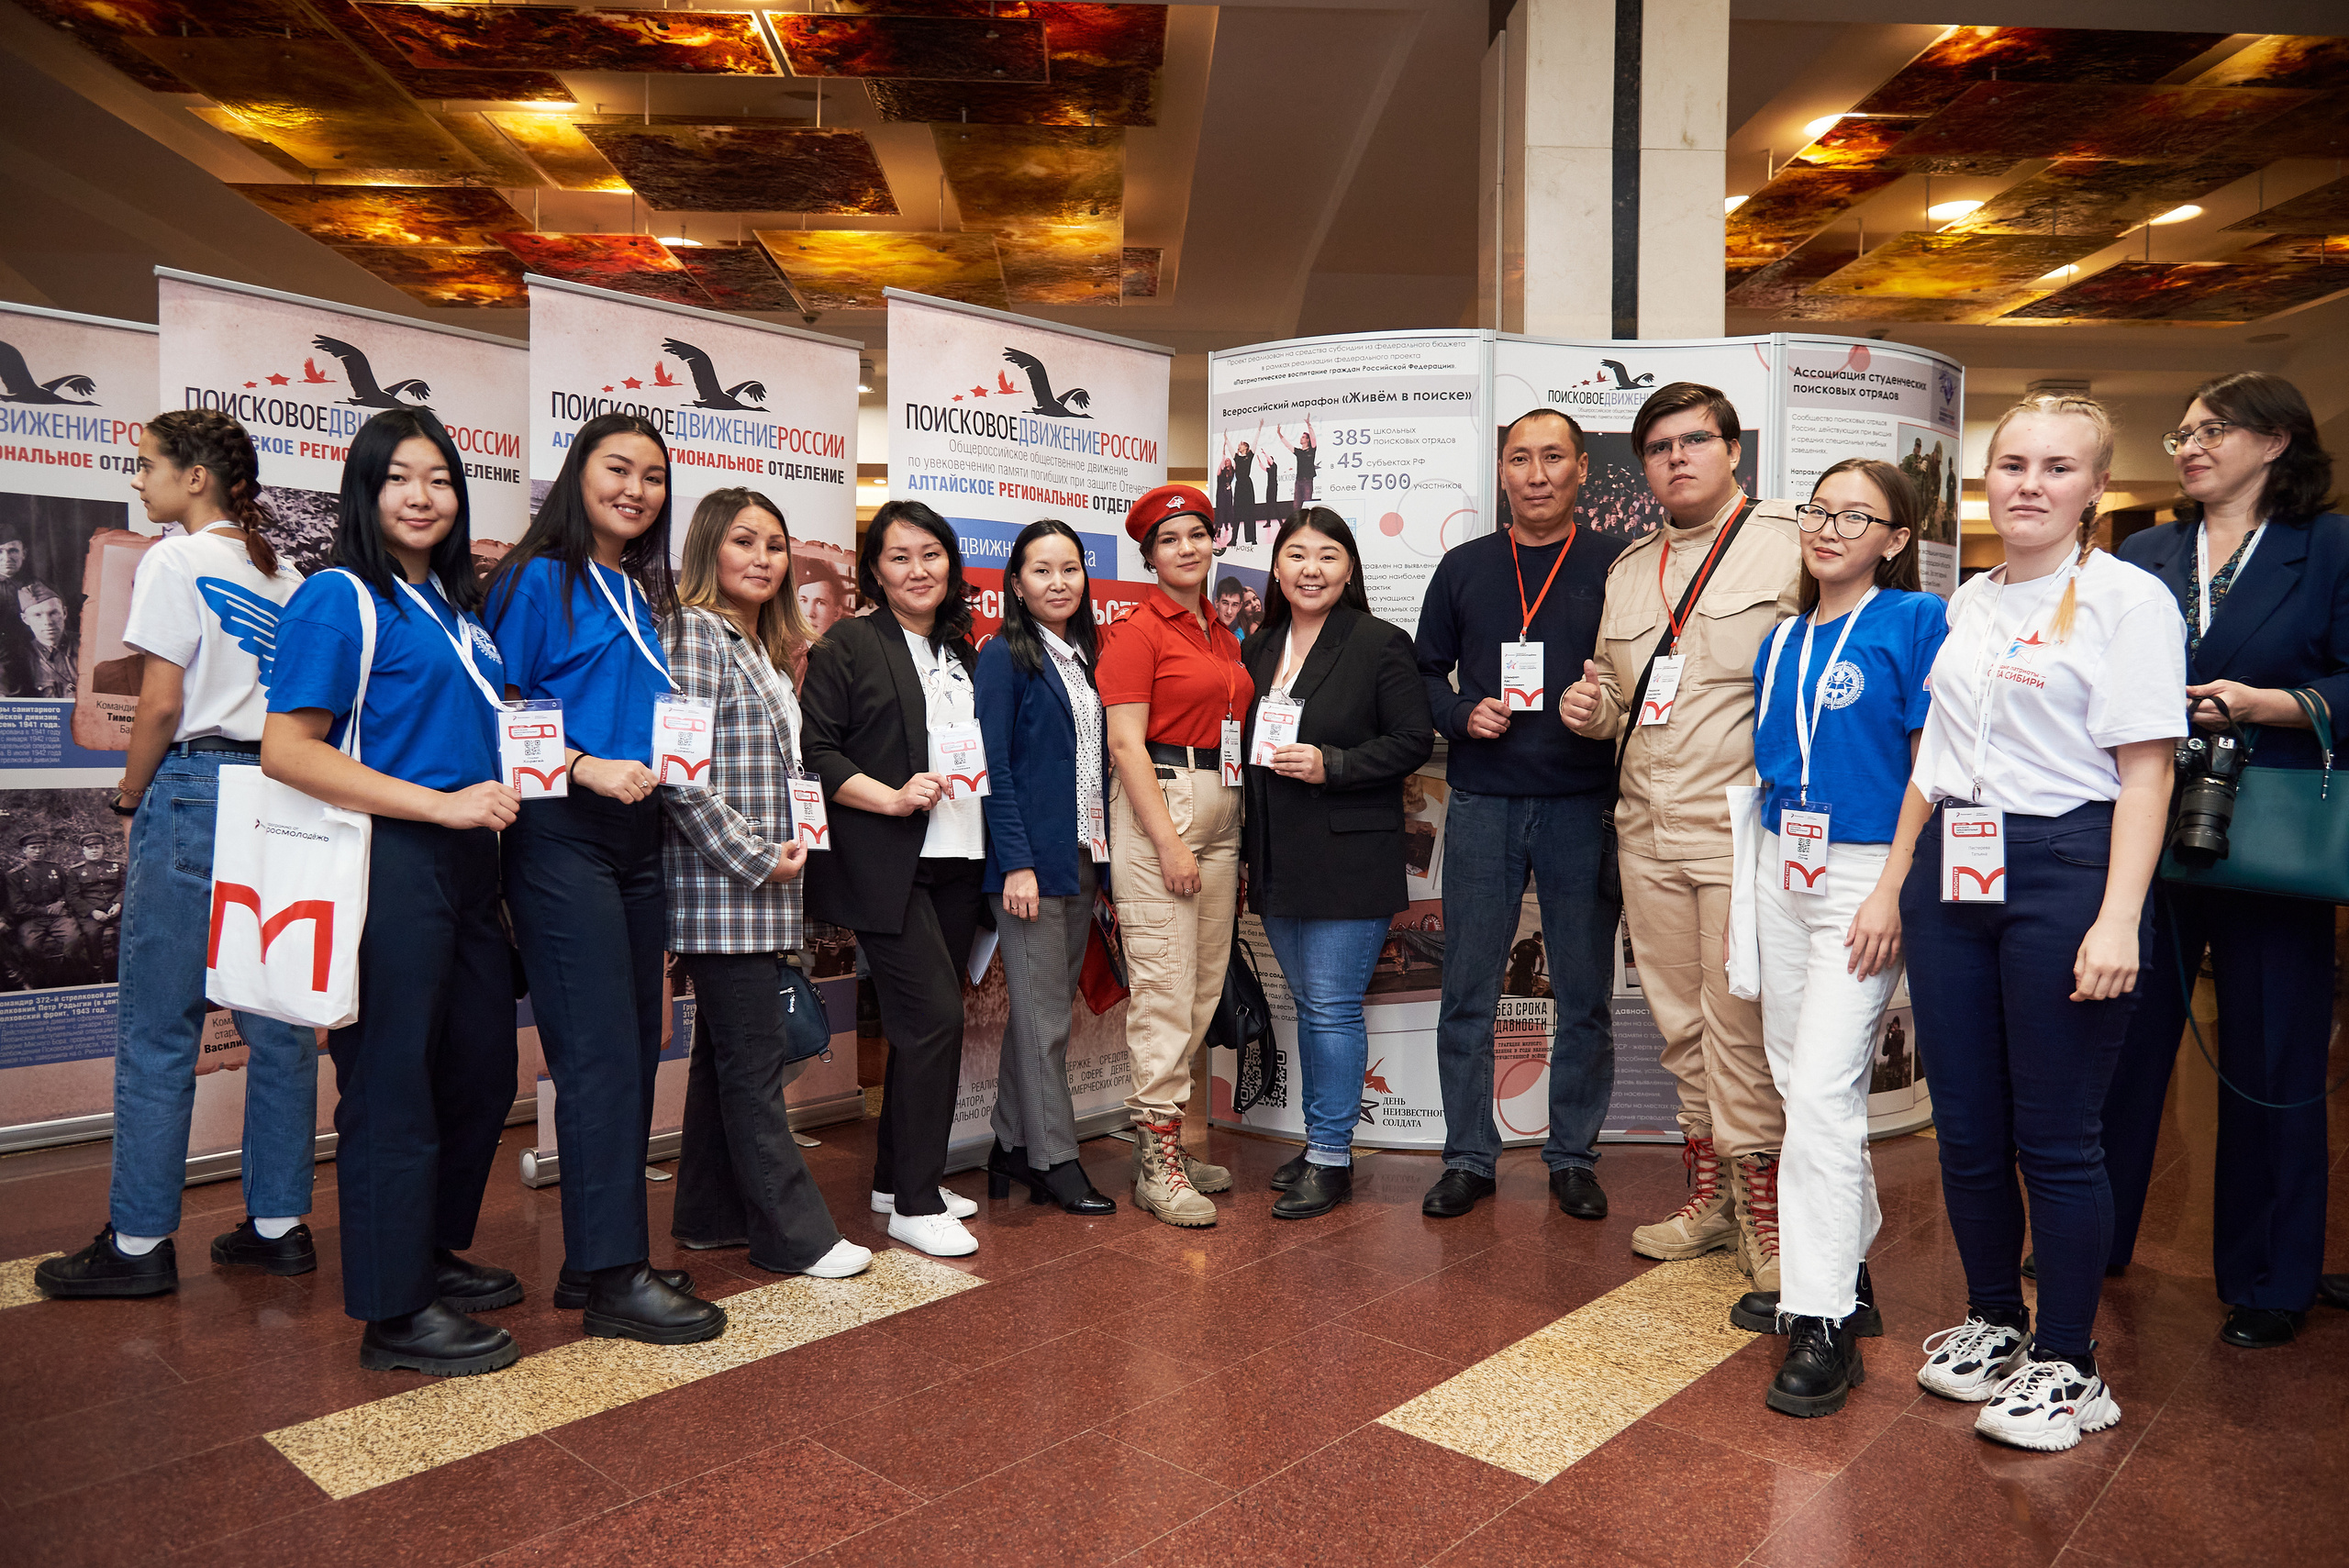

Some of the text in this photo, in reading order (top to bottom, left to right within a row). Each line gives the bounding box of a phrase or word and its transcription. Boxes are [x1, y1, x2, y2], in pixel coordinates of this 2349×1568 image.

[1227, 358, 1247, 367] Проект
[1248, 353, 1285, 365] реализован
[1295, 347, 1328, 357] средства
[1328, 344, 1364, 353] субсидии
[1374, 341, 1431, 350] федерального
[1431, 339, 1466, 348] бюджета
[1266, 362, 1290, 371] рамках
[1291, 358, 1333, 368] реализации
[1333, 353, 1389, 364] федерального
[1389, 352, 1421, 361] проекта
[1287, 368, 1328, 379] воспитание
[1329, 367, 1361, 376] граждан
[1362, 363, 1407, 372] Российской
[1793, 366, 1928, 391] Ассоциация студенческих
[1793, 384, 1899, 401] поисковых отрядов
[1222, 390, 1472, 417] Всероссийский марафон «Живём в поиске»
[0, 406, 143, 447] ВИЖЕНИЕРО
[1791, 413, 1832, 422] Сообщество
[1834, 417, 1865, 425] поисковых
[906, 402, 1157, 464] ПОИСКОВОЕДВИЖЕНИЕРОССИИ
[1332, 428, 1371, 446] 385
[1818, 427, 1860, 435] действующих
[1373, 436, 1456, 445] поисковых отрядов
[0, 445, 94, 469] НАЛЬНОЕ
[668, 447, 844, 484] ГИОНАЛЬНОЕ ОТДЕЛЕНИЕ
[949, 439, 1129, 476] Общероссийское общественное движение
[1337, 451, 1364, 469] 45
[1366, 459, 1410, 468] субъектах
[1412, 458, 1426, 466] РФ
[907, 456, 920, 468] по
[923, 457, 996, 473] увековечению
[997, 463, 1029, 478] памяти
[1030, 469, 1068, 484] погибших
[1070, 475, 1085, 488] при
[1086, 478, 1118, 492] защите
[1330, 484, 1357, 492] более
[1357, 473, 1411, 491] 7500
[1413, 482, 1463, 491] участников
[907, 473, 1138, 515] АЛТАЙСКОЕ РЕГИОНАЛЬНОЕ ОТДЕЛ
[2004, 671, 2045, 690] СИБИРИ
[25, 714, 61, 722] дивизии.
[265, 827, 329, 843] росмолодёжь
[35, 991, 105, 1004] 372-й стрелковой
[38, 1004, 57, 1012] Петр
[72, 1006, 108, 1016] 1943 год.
[1496, 1001, 1548, 1017] БЕЗ СРОКА
[1495, 1017, 1548, 1034] ДАВНОСТИ
[1068, 1073, 1074, 1084] В
[1081, 1067, 1104, 1082] СФЕРЕ
[1110, 1062, 1131, 1077] ДЕЯТЕ
[971, 1077, 999, 1094] РЕАЛИЗ
[1382, 1096, 1406, 1106] ДЕНЬ
[1383, 1107, 1444, 1118] НЕИЗВЕСТНОГ
[1382, 1118, 1422, 1129] СОЛДАТА
